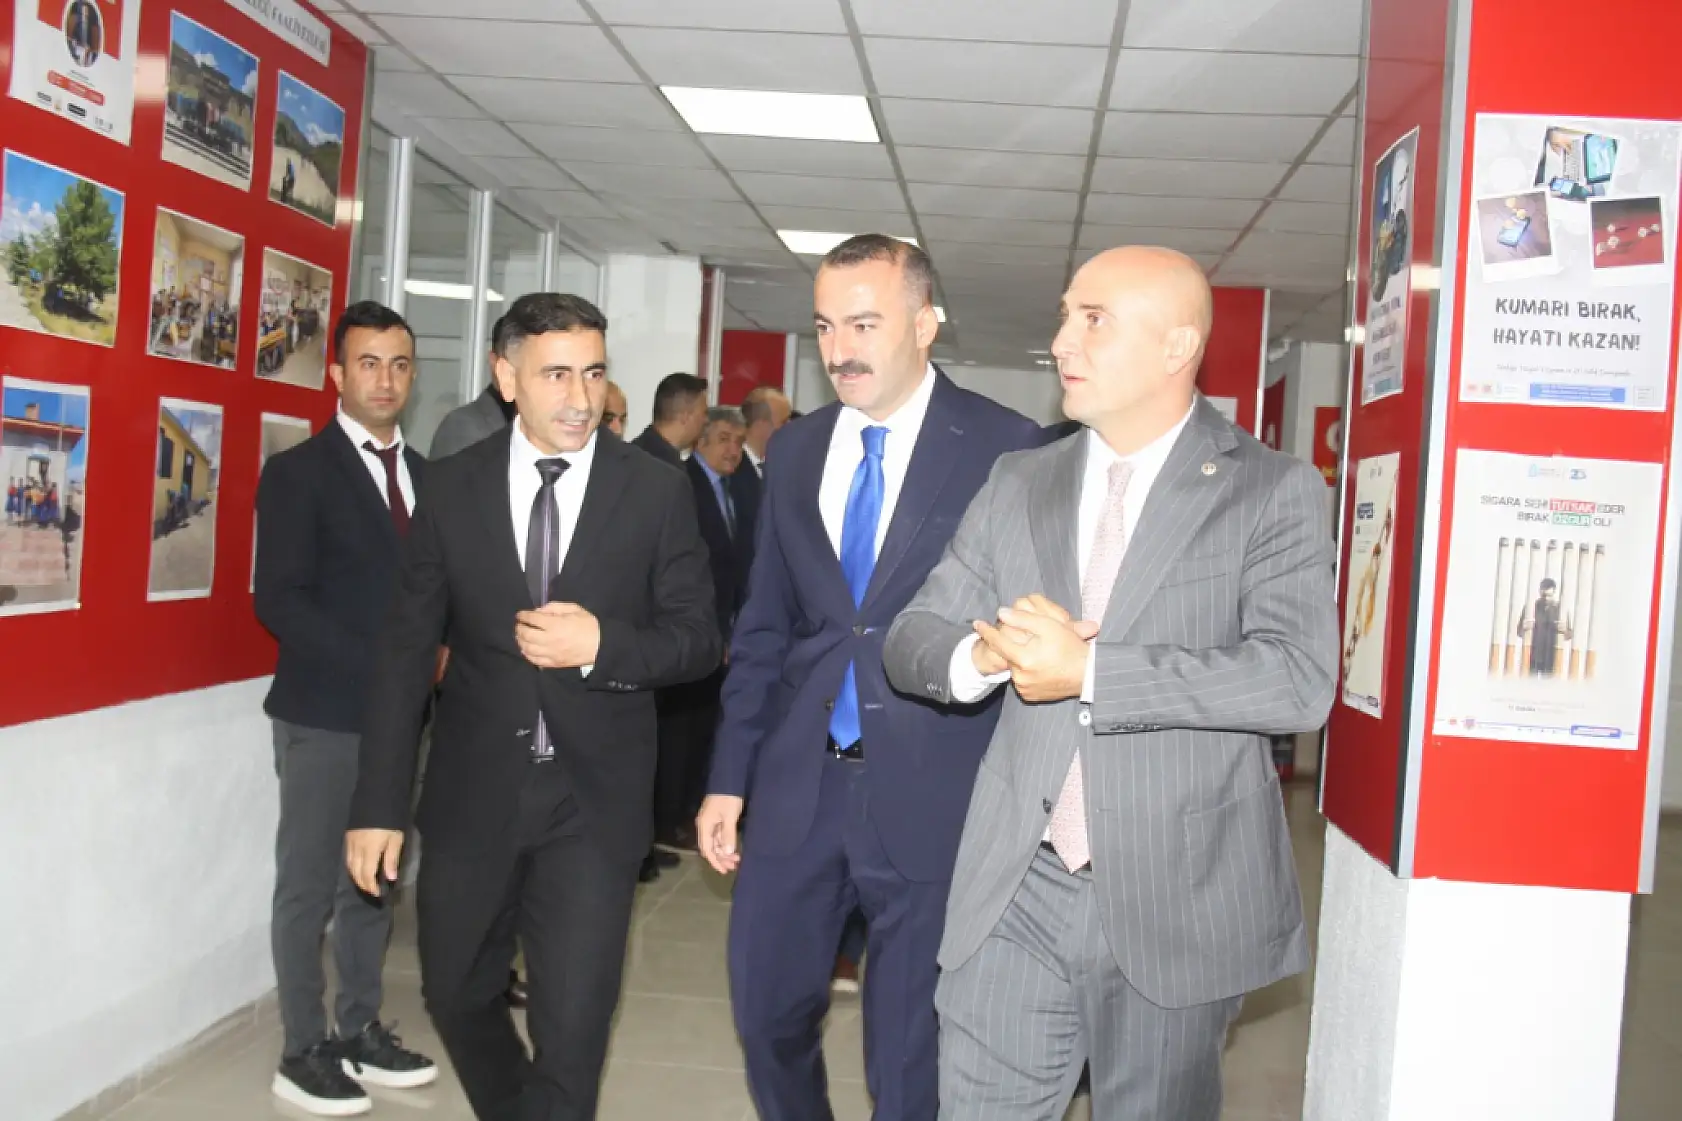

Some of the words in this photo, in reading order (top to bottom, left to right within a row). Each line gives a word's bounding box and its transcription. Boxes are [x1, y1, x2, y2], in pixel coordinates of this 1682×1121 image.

[1495, 297, 1570, 317] KUMARI
[1577, 301, 1642, 323] BIRAK,
[1493, 327, 1562, 347] HAYATI
[1567, 331, 1641, 351] KAZAN!
